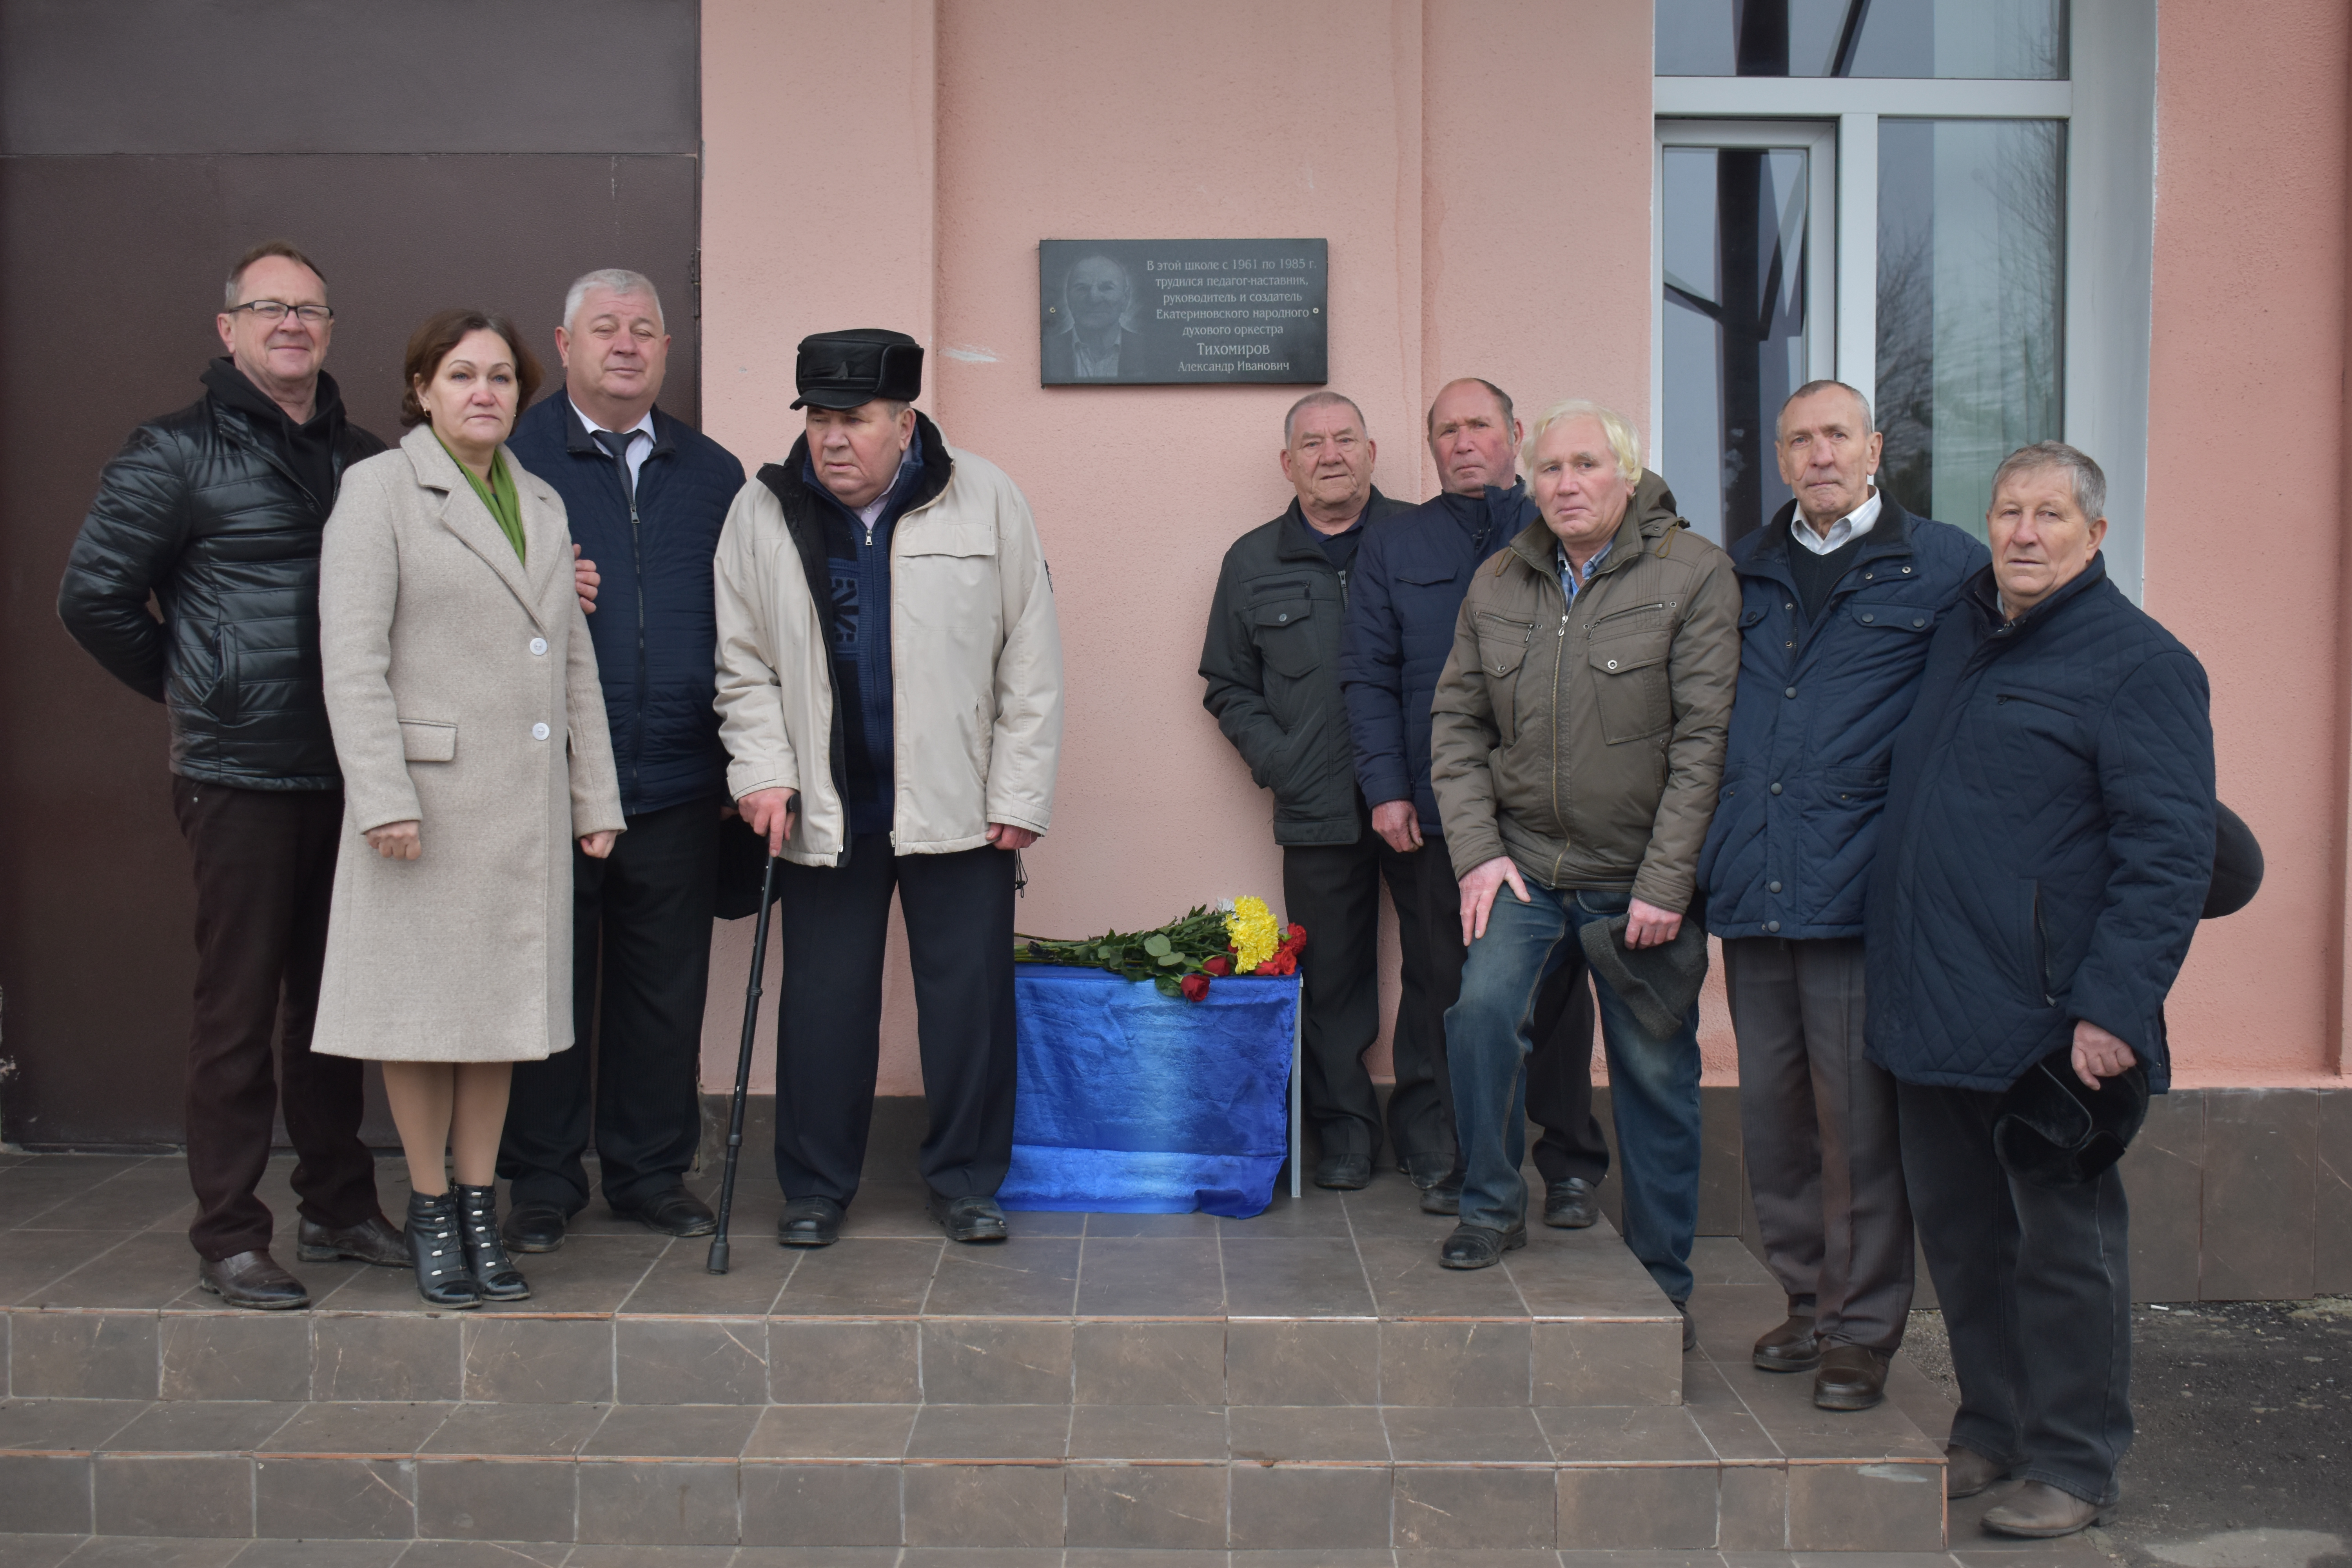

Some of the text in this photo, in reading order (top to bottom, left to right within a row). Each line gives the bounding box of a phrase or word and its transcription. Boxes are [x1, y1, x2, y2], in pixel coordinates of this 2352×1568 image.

[1147, 258, 1317, 270] В этой школе с 1961 по 1985 г.
[1155, 277, 1308, 289] трудился педагог-наставник,
[1163, 294, 1237, 306] руководитель
[1249, 293, 1303, 302] создатель
[1156, 309, 1309, 321] Екатериновского народного
[1182, 326, 1283, 338] духового оркестра
[1197, 343, 1270, 358] Тихомиров
[1178, 361, 1290, 374] Александр Иванович
